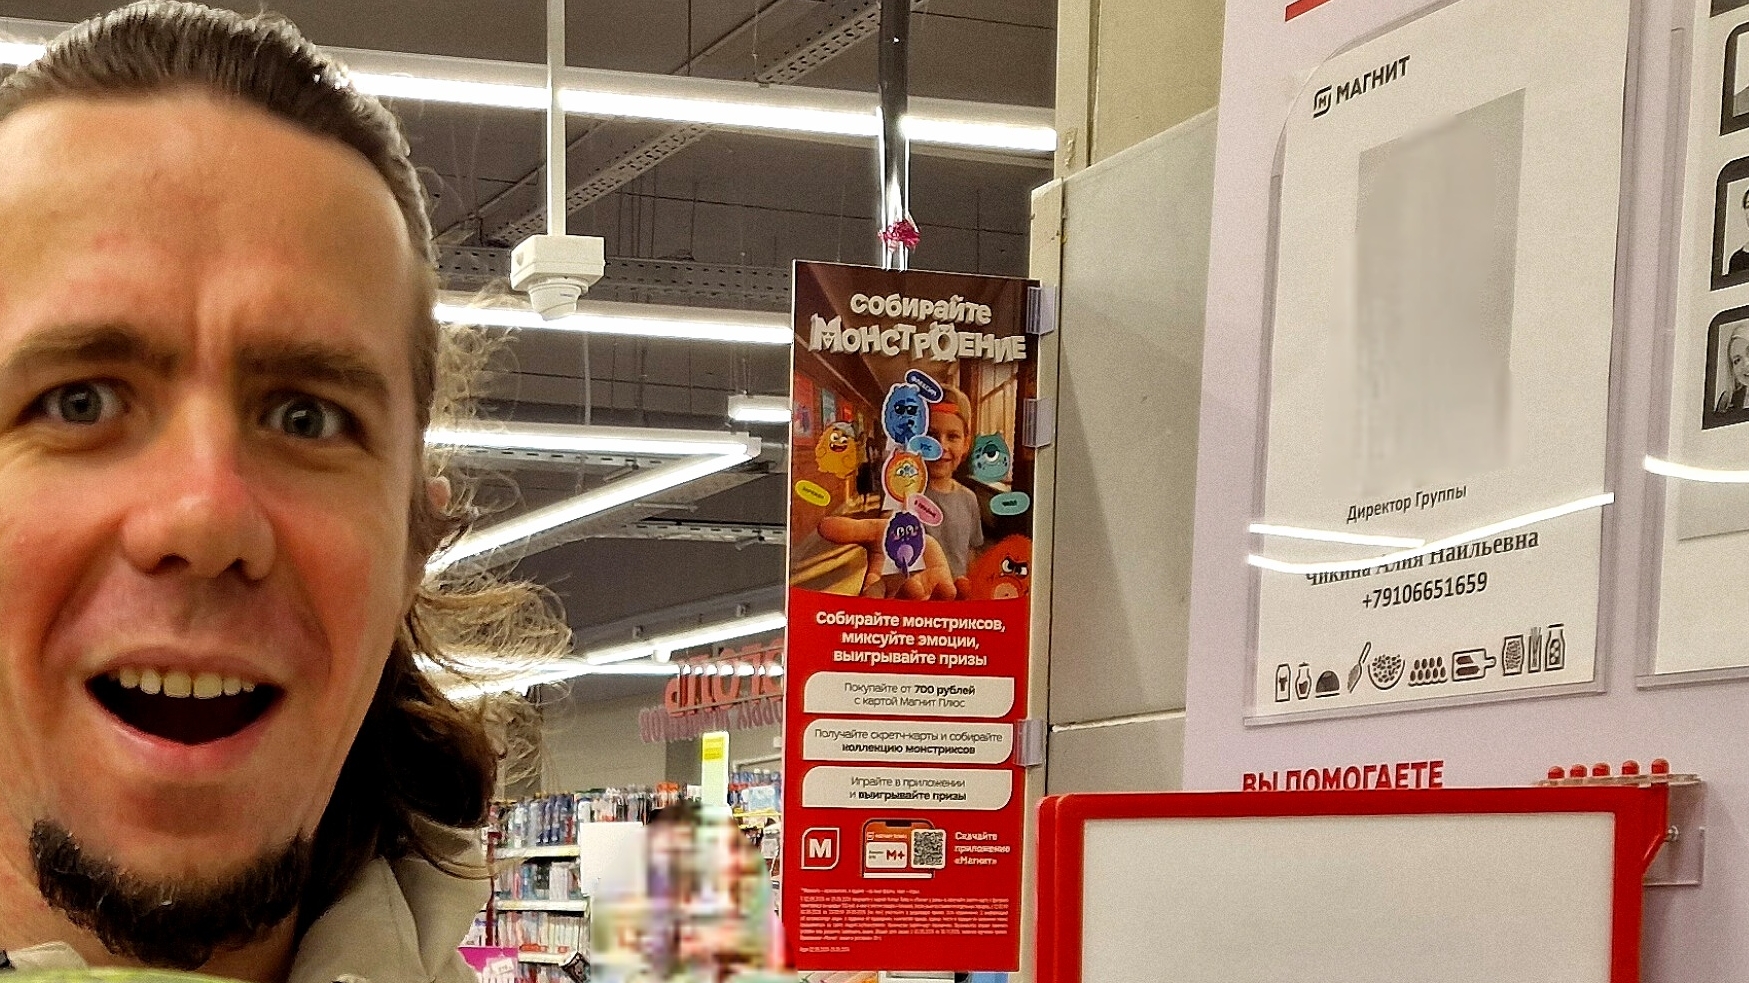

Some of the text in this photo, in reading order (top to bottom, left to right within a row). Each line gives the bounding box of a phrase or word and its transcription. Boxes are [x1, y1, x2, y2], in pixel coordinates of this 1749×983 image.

[1335, 54, 1411, 105] МАГНИТ
[1346, 485, 1468, 524] Директор Группы
[1428, 530, 1540, 566] Наильевна
[1362, 571, 1489, 609] +79106651659
[815, 611, 1007, 633] Собирайте монстриксов,
[841, 630, 980, 650] миксуйте эмоции,
[833, 649, 988, 669] выигрывайте призы
[844, 682, 976, 697] Покупайте от 700 рублей
[862, 695, 898, 707] картой
[899, 697, 936, 707] Магнит
[938, 698, 966, 708] Плюс
[814, 728, 869, 742] Получайте
[949, 732, 1003, 743] собирайте
[842, 743, 903, 754] коллекцию
[851, 776, 893, 788] Играйте
[902, 778, 966, 789] приложении
[1243, 760, 1444, 792] ВЫ ПОМОГАЕТЕ
[858, 790, 931, 802] выигрывайте
[932, 792, 967, 803] призы
[954, 831, 998, 843] Скачайте
